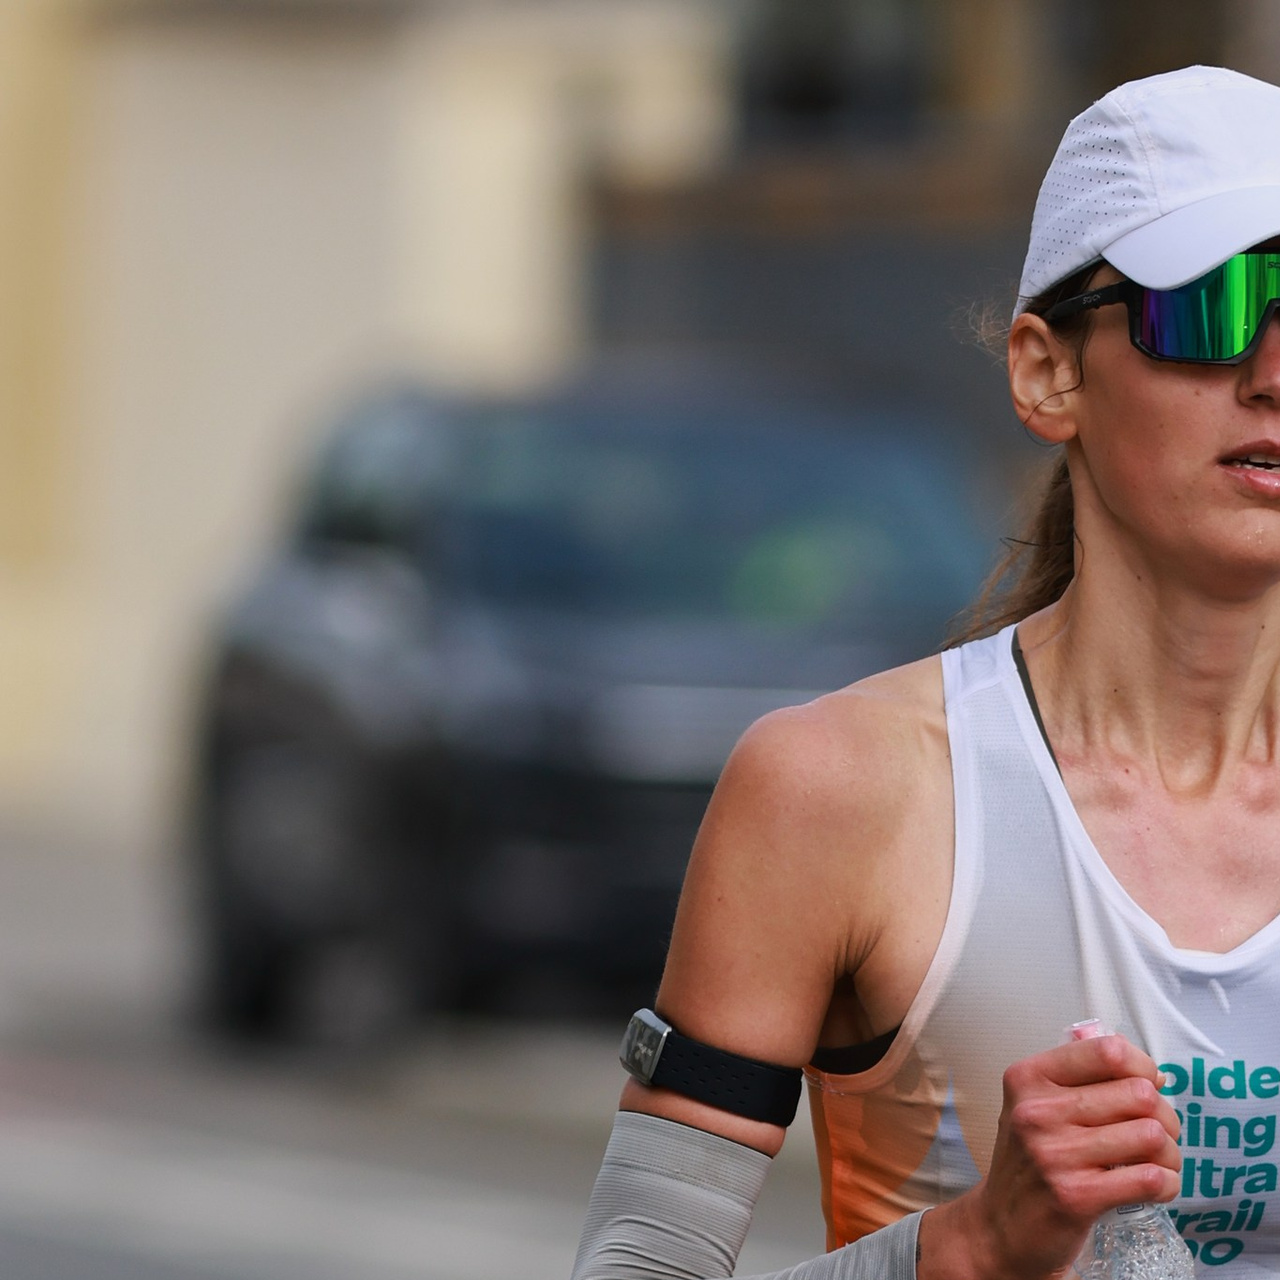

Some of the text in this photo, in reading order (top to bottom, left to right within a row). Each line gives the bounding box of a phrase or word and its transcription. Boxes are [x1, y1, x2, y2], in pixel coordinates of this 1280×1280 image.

[1177, 1102, 1277, 1158] ing
[1181, 1157, 1279, 1199] ltra
[1172, 1199, 1266, 1234] rail
